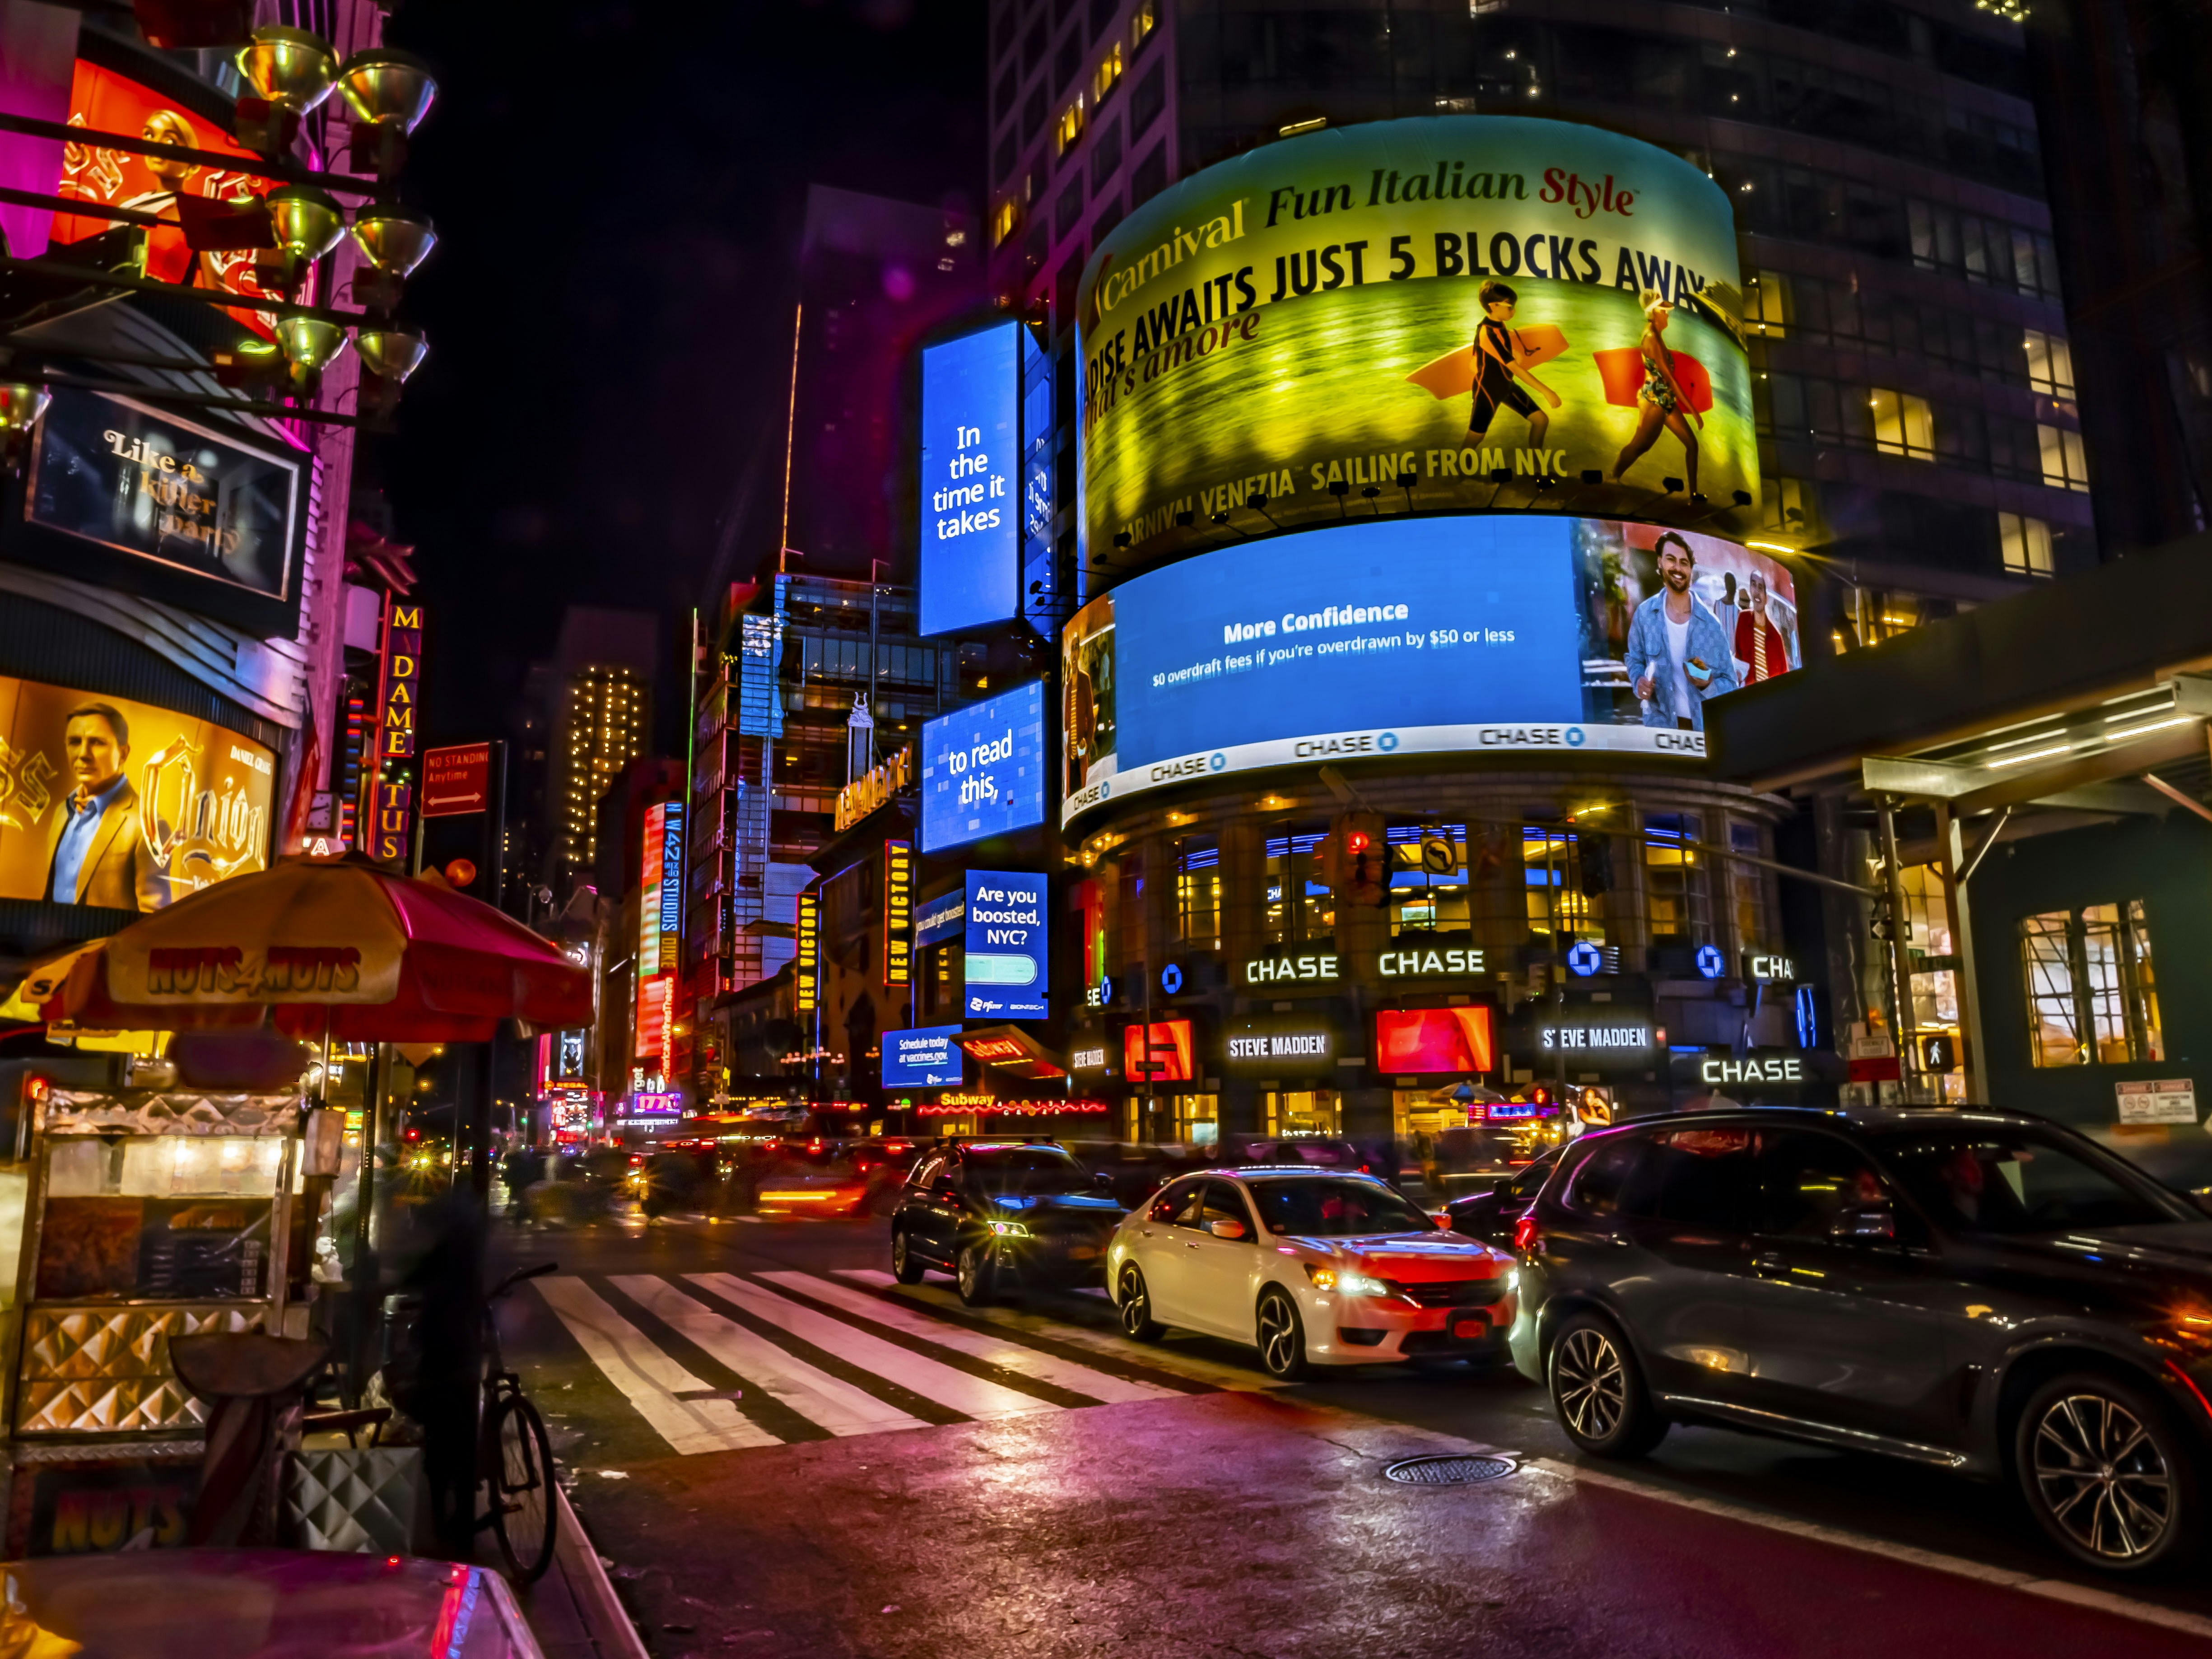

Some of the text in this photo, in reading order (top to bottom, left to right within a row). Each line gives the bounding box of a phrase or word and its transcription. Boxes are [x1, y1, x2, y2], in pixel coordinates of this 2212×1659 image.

[1265, 161, 1635, 228] Fun Italian Style
[1103, 199, 1246, 312] Carnival
[1133, 266, 1257, 359] AWAITS
[1270, 240, 1368, 303] JUST
[1389, 235, 1416, 280] 5
[1434, 231, 1602, 284] BLOCKS
[1143, 312, 1261, 382] amore
[956, 426, 980, 450] In
[103, 429, 205, 484] Like a
[949, 453, 987, 480] the
[140, 471, 217, 515] killer
[932, 475, 1006, 513] time it
[1201, 468, 1295, 516] VENEZIA
[1311, 451, 1416, 491] SAILING
[1426, 447, 1504, 478] FROM
[1514, 448, 1569, 477] NYC
[158, 514, 242, 555] party
[936, 507, 1001, 541] takes
[1224, 601, 1409, 645] More Confidence
[1152, 628, 1516, 688] $0 overdraft fees if you're overdrawn by $50 or less
[428, 757, 442, 768] NO
[949, 728, 1012, 776] to read
[428, 769, 468, 784] Anytime
[1074, 728, 1705, 811] CHASE CHASE CHASE CHASE CHAS
[961, 772, 999, 805] this,
[665, 802, 683, 831] NW
[661, 878, 680, 932] STUDIOS
[890, 845, 909, 981] NEW VICTORY
[976, 886, 1037, 907] Are you
[973, 907, 1041, 927] boosted,
[661, 937, 676, 969] DUKE
[799, 897, 816, 1010] NEW VICTORY
[987, 929, 1028, 946] NYC?
[147, 946, 362, 997] NUTS4NUTS
[1246, 955, 1340, 984] CHASE
[1378, 949, 1485, 976] CHASE
[1087, 988, 1101, 1007] SE
[899, 1036, 948, 1050] Schedule today
[1229, 1035, 1326, 1058] STEVE MADDEN
[1542, 1027, 1647, 1049] SEVE MADDEN
[1702, 1058, 1803, 1083] CHASE
[941, 1093, 996, 1107] Subway
[51, 1489, 185, 1551] NUTS
